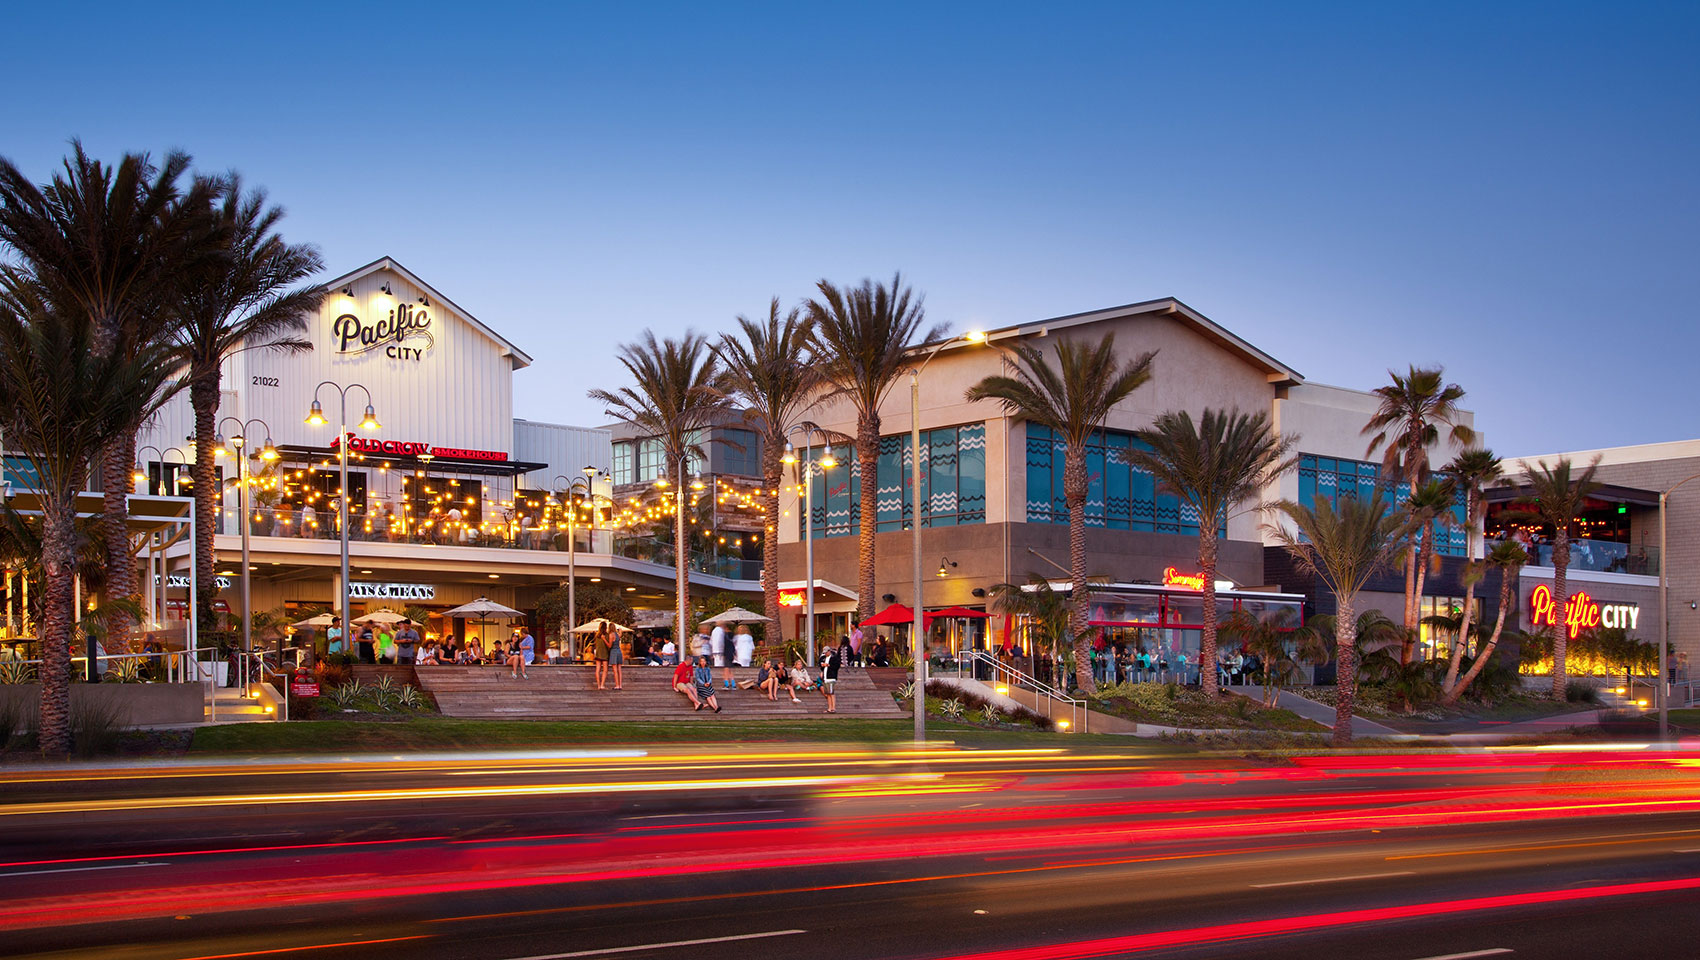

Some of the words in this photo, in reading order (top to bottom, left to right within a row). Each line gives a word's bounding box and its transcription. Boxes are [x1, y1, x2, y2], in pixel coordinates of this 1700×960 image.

[334, 303, 432, 352] Pacific
[386, 346, 422, 361] CITY
[252, 375, 279, 387] 21022
[349, 437, 381, 453] OLD
[382, 440, 430, 456] CROW
[434, 447, 508, 461] SMOKEHOUSE
[377, 584, 387, 598] &
[388, 585, 435, 599] MEANS
[1532, 584, 1600, 639] Paific
[1602, 604, 1640, 630] CITY
